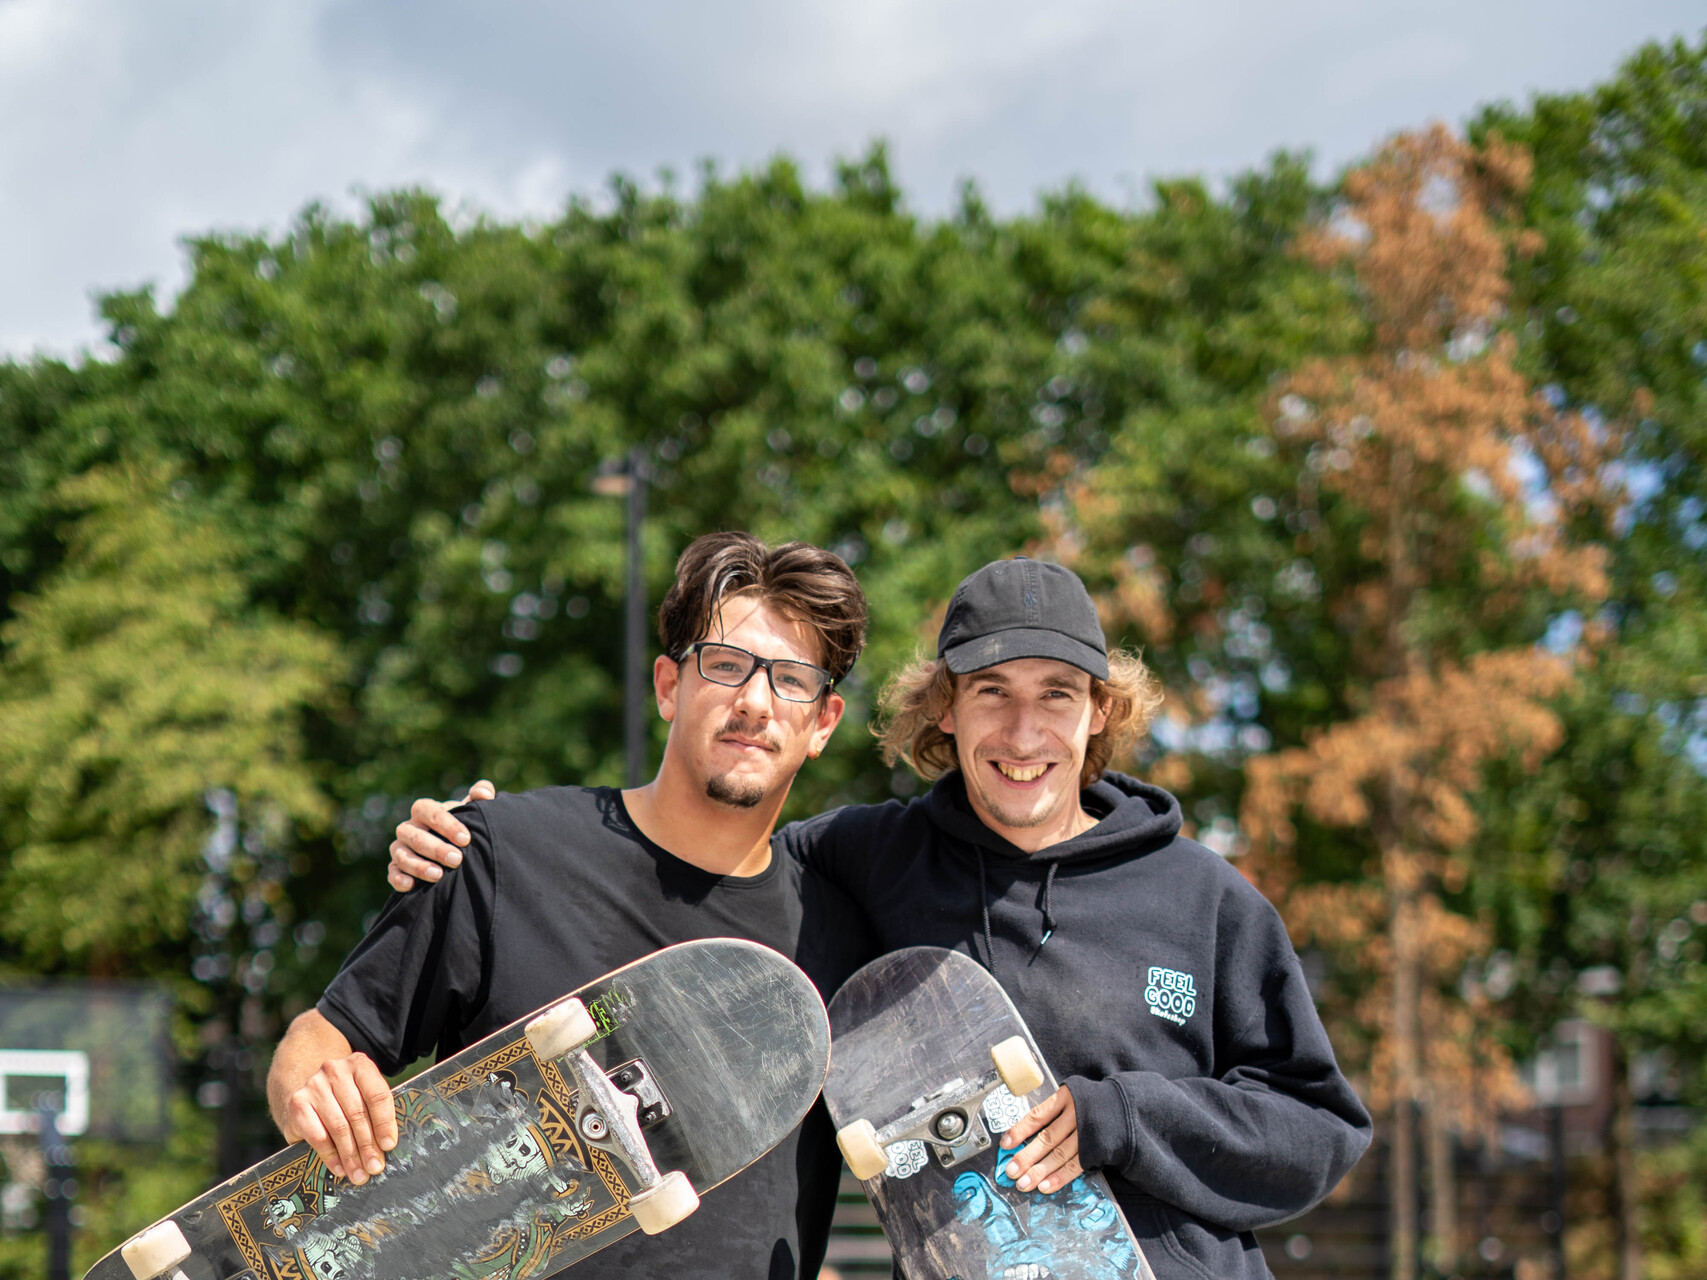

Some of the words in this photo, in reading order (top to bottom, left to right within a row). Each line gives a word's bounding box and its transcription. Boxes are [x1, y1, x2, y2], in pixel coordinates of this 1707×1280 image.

[1148, 966, 1197, 996] FEEL
[1144, 985, 1196, 1017] GOOD
[891, 1141, 911, 1176] OOD
[907, 1140, 926, 1170] EEL
